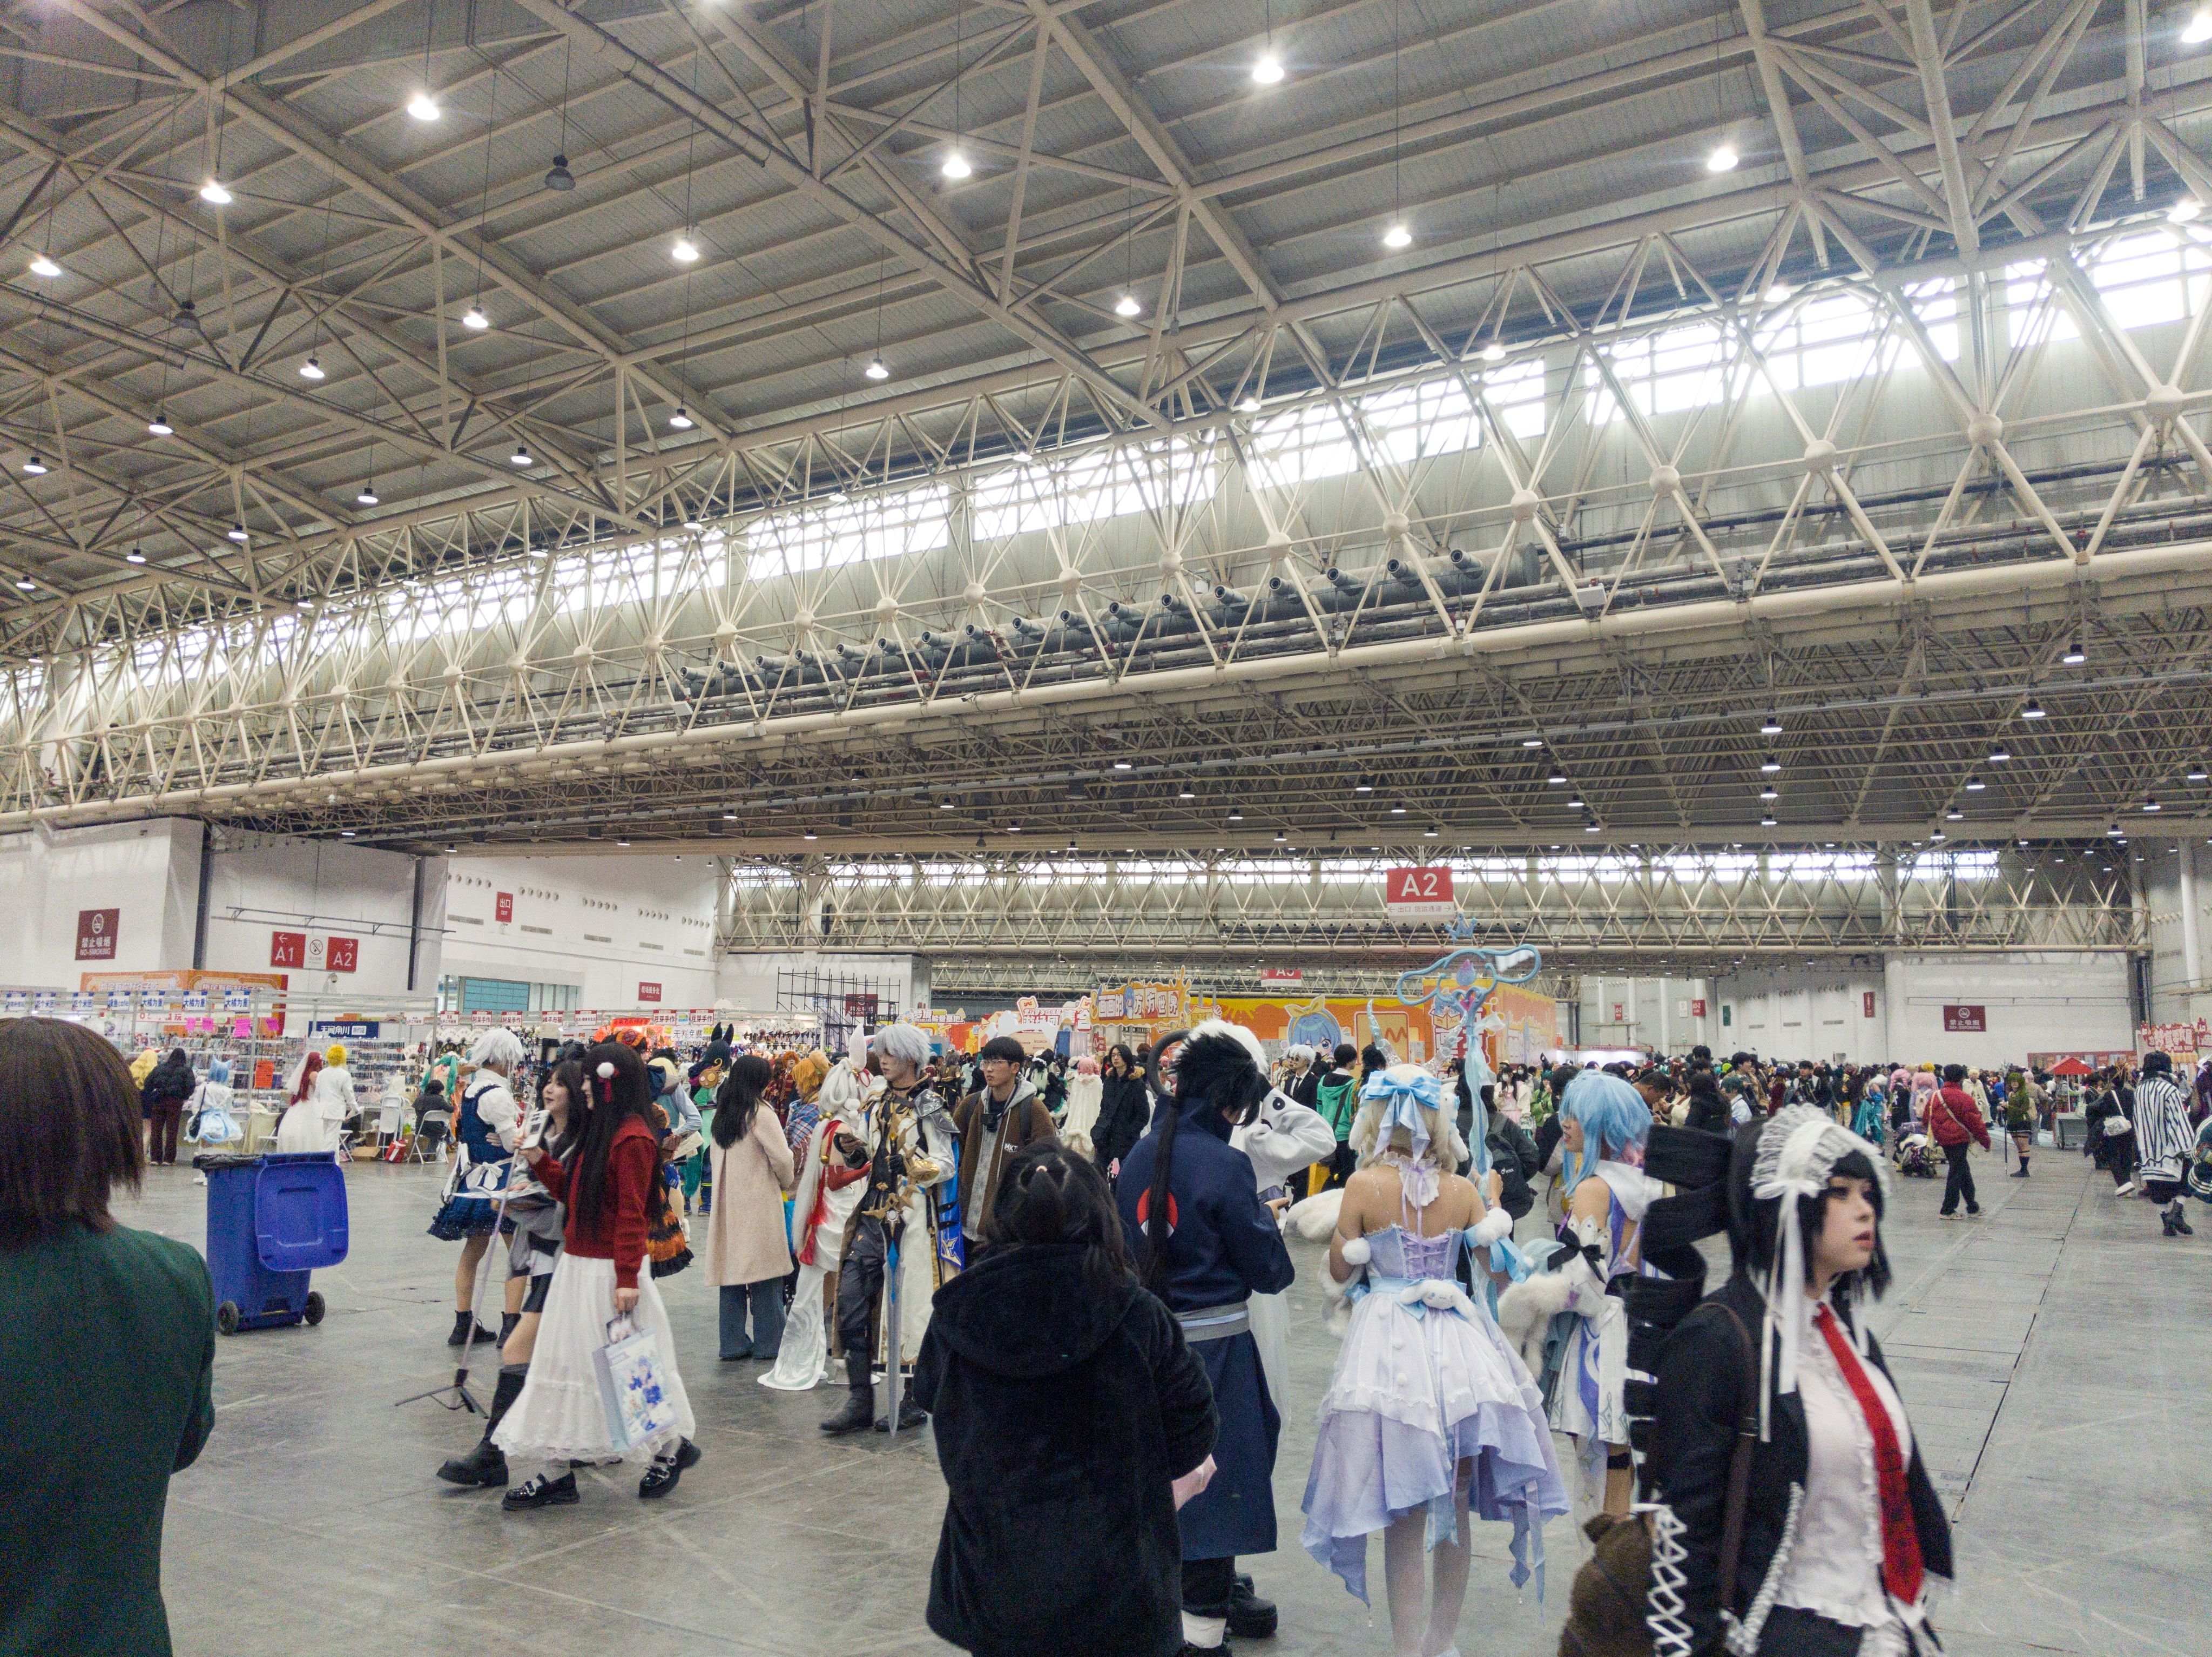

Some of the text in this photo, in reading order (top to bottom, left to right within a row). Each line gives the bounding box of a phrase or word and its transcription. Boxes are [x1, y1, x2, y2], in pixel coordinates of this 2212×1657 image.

[1401, 873, 1438, 897] A2
[500, 898, 511, 908] 出口
[81, 936, 111, 948] 禁止吸烟
[275, 946, 294, 962] A1
[333, 951, 352, 967] A2
[142, 998, 163, 1007] 大橘为重
[184, 998, 205, 1007] 大橘为重
[226, 998, 248, 1007] 大橘为重
[320, 1025, 349, 1035] 天闻角川
[673, 1028, 703, 1039] 无料免费
